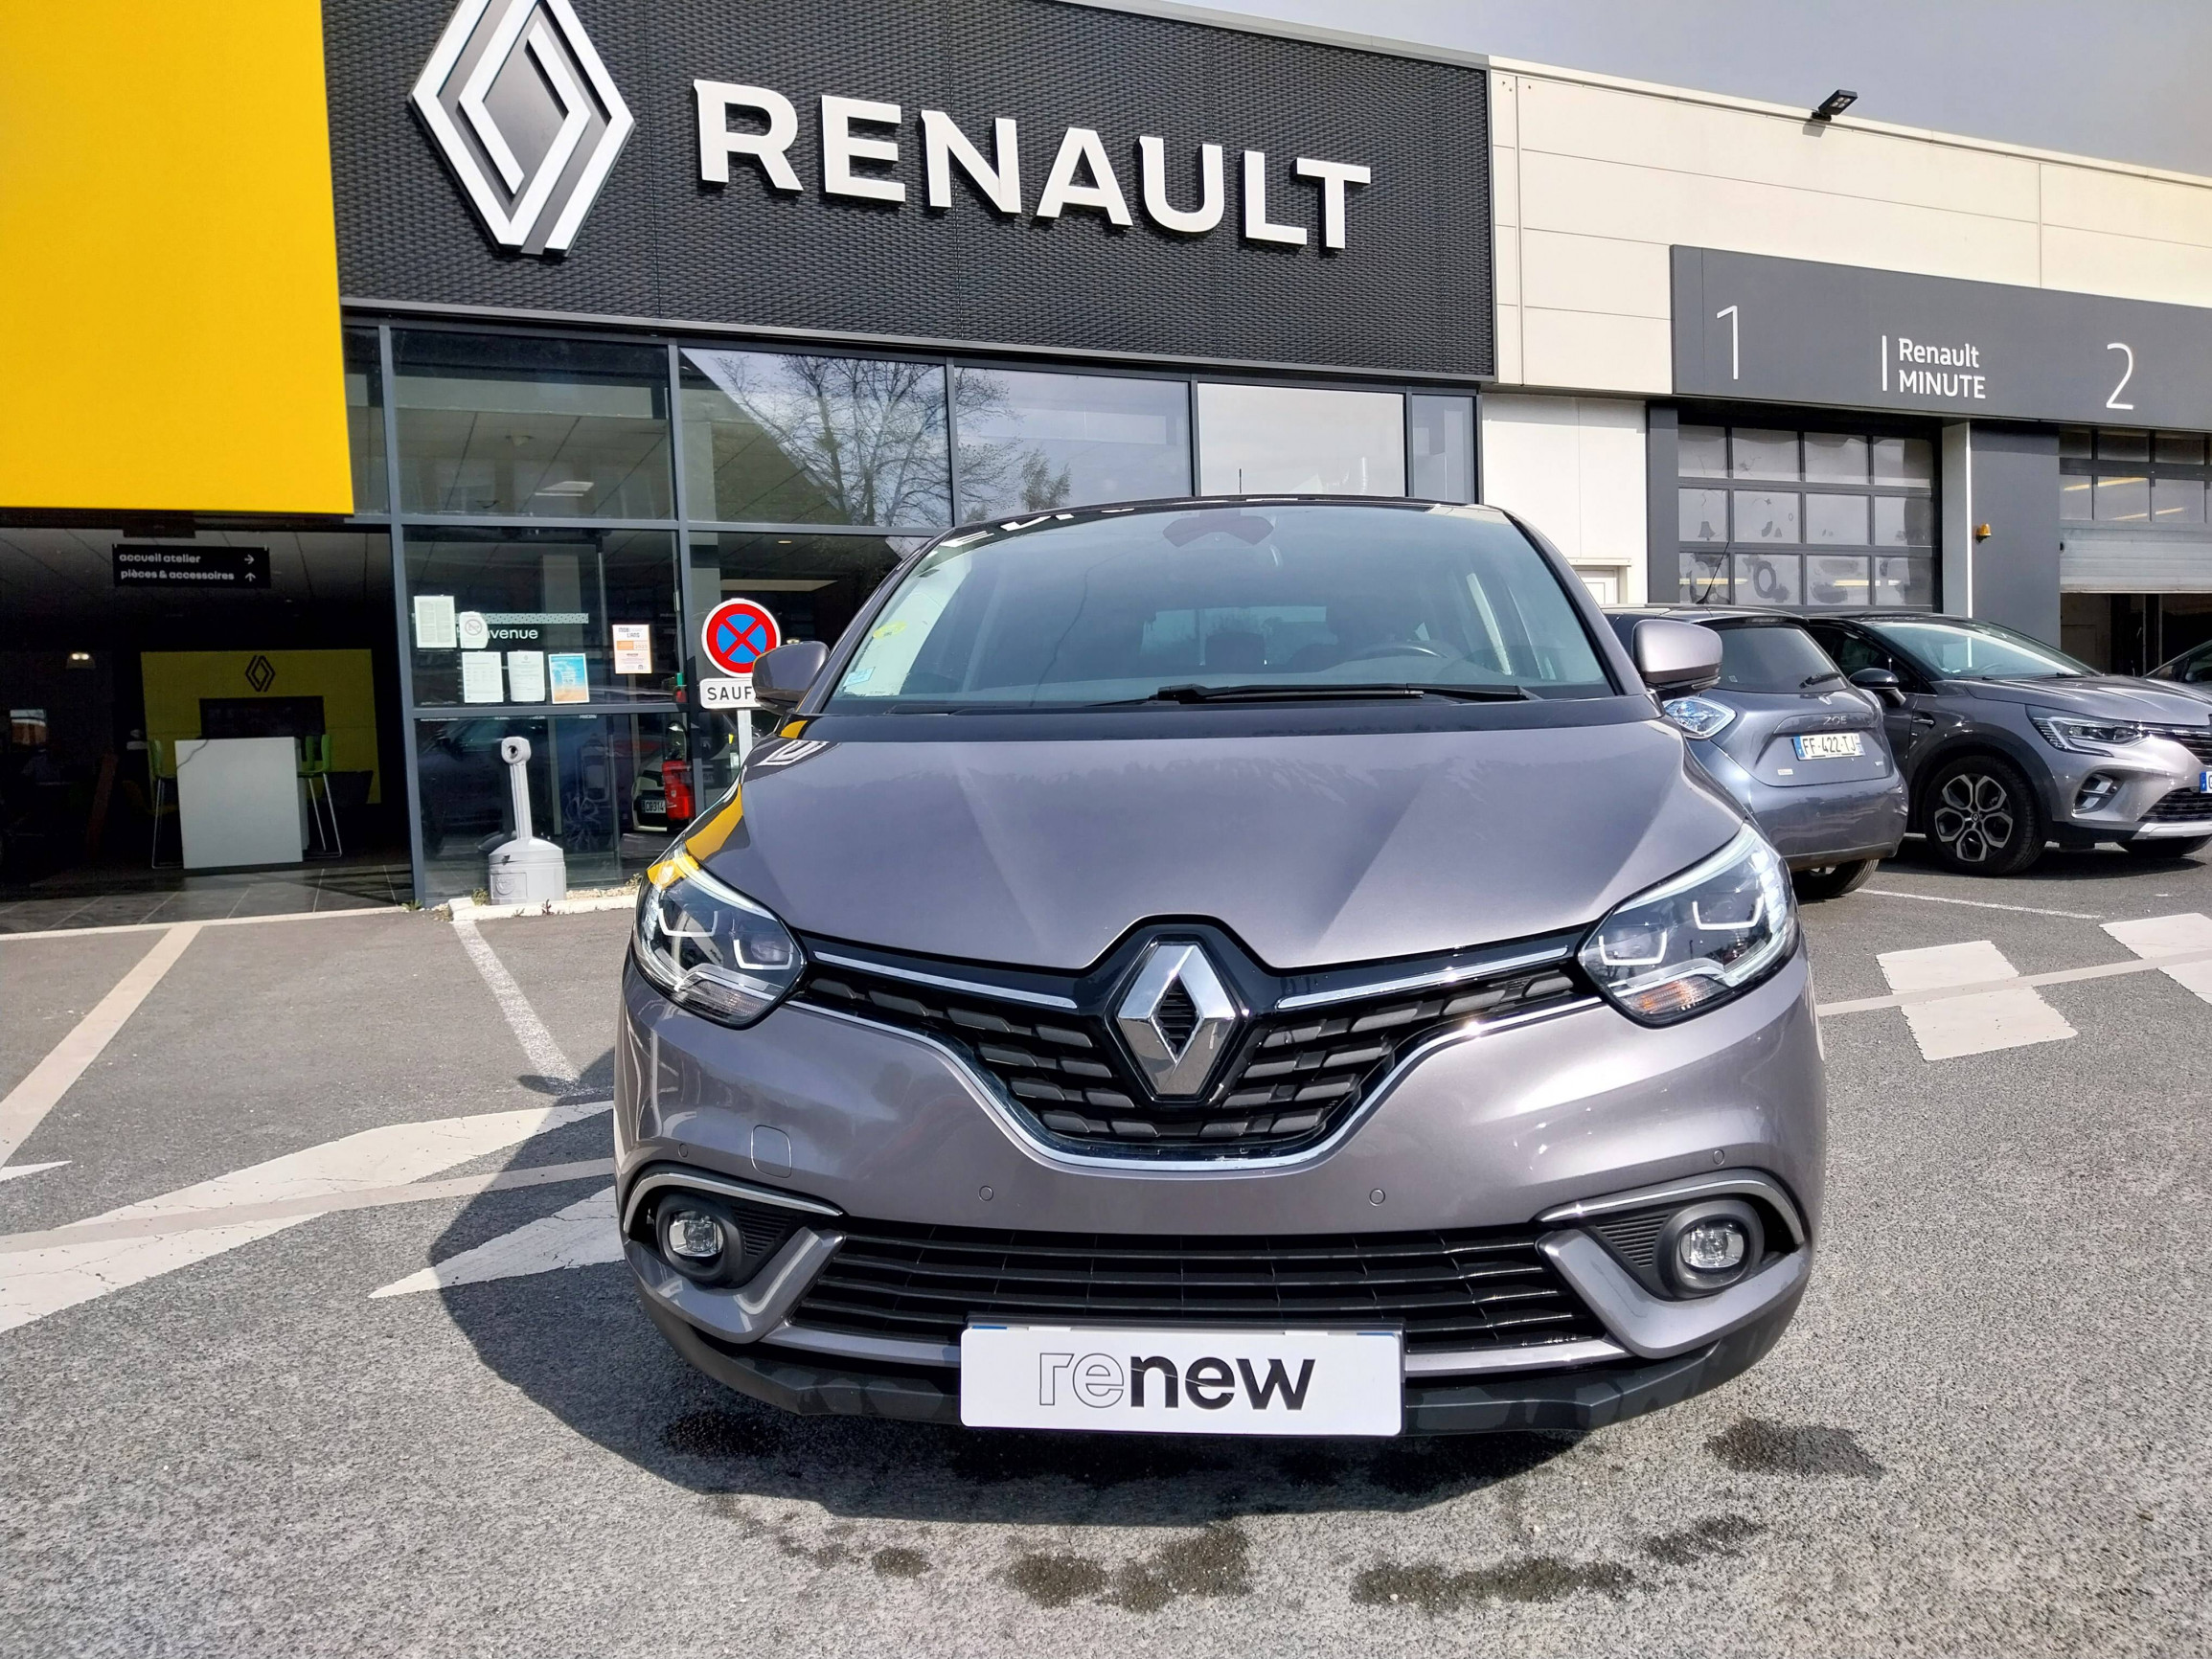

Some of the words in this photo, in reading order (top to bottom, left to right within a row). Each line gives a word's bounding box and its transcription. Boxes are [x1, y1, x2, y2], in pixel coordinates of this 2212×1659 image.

[694, 79, 1372, 253] RENAULT
[1716, 305, 1739, 381] 1
[1898, 337, 1979, 370] Renault
[1898, 370, 1986, 400] MINUTE
[2106, 342, 2135, 411] 2
[119, 553, 162, 562] accueil
[163, 554, 201, 563] atelier
[121, 568, 158, 580] pièces
[159, 570, 168, 579] &
[169, 570, 235, 580] accessoires
[707, 686, 753, 701] SAUF
[1038, 1352, 1316, 1411] renew
